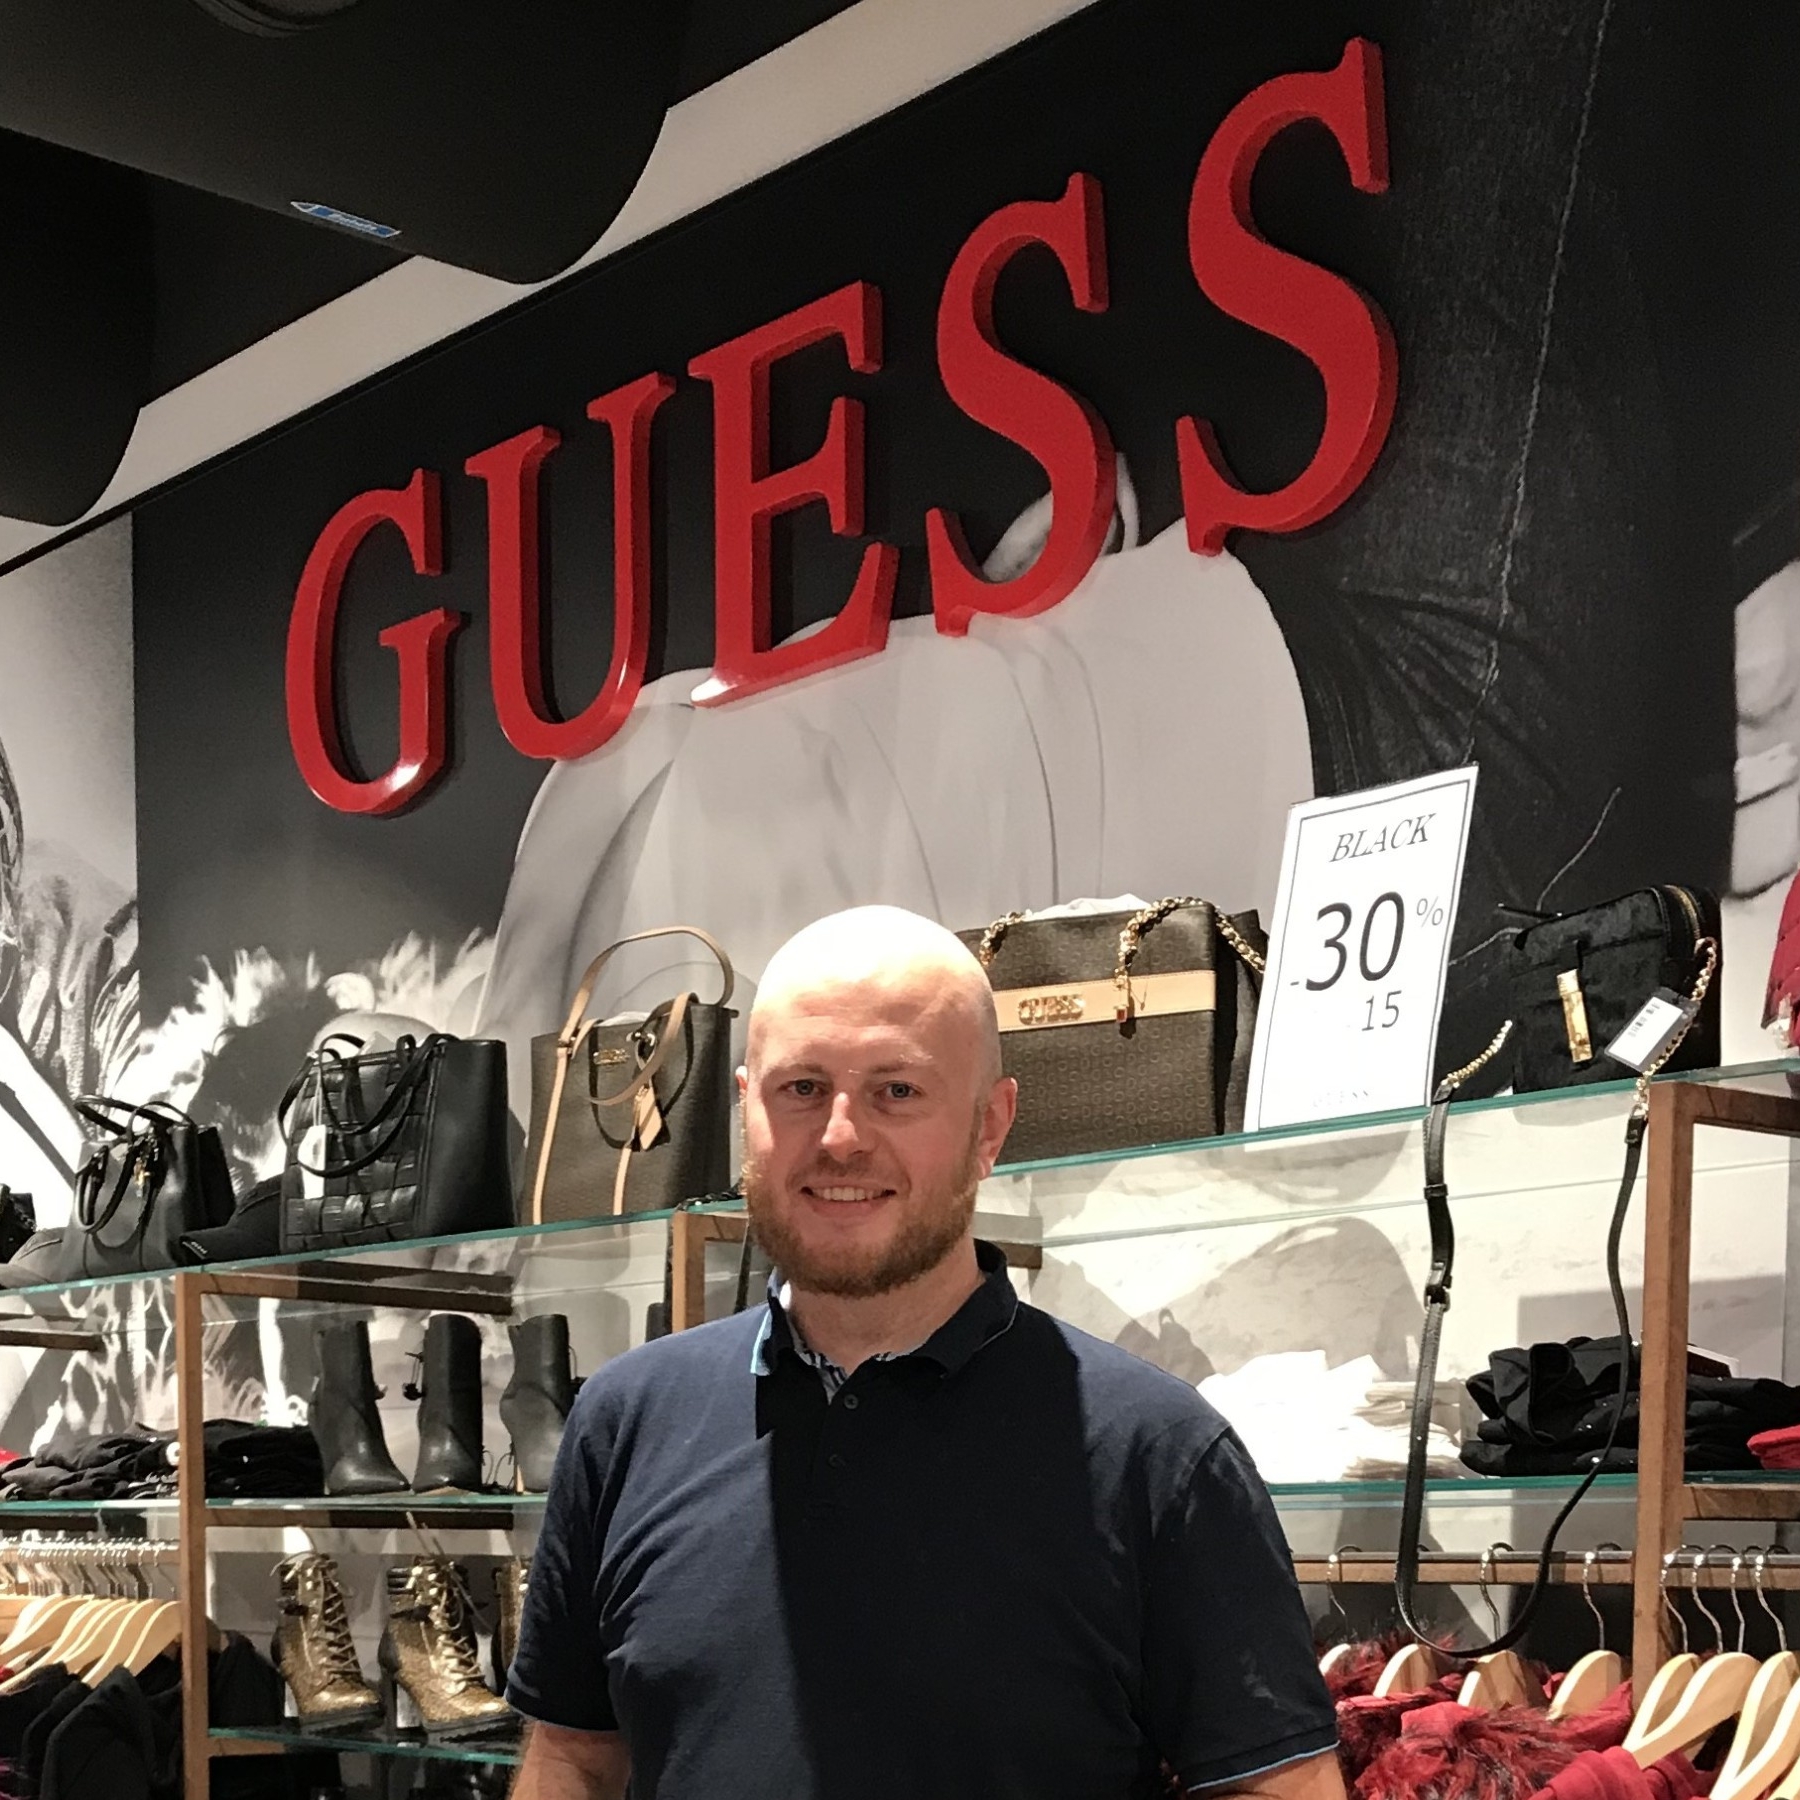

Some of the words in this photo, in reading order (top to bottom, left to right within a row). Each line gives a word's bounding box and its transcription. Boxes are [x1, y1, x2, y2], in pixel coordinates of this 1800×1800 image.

[284, 36, 1399, 815] GUESS
[1331, 813, 1436, 862] BLACK
[1361, 990, 1402, 1032] 15
